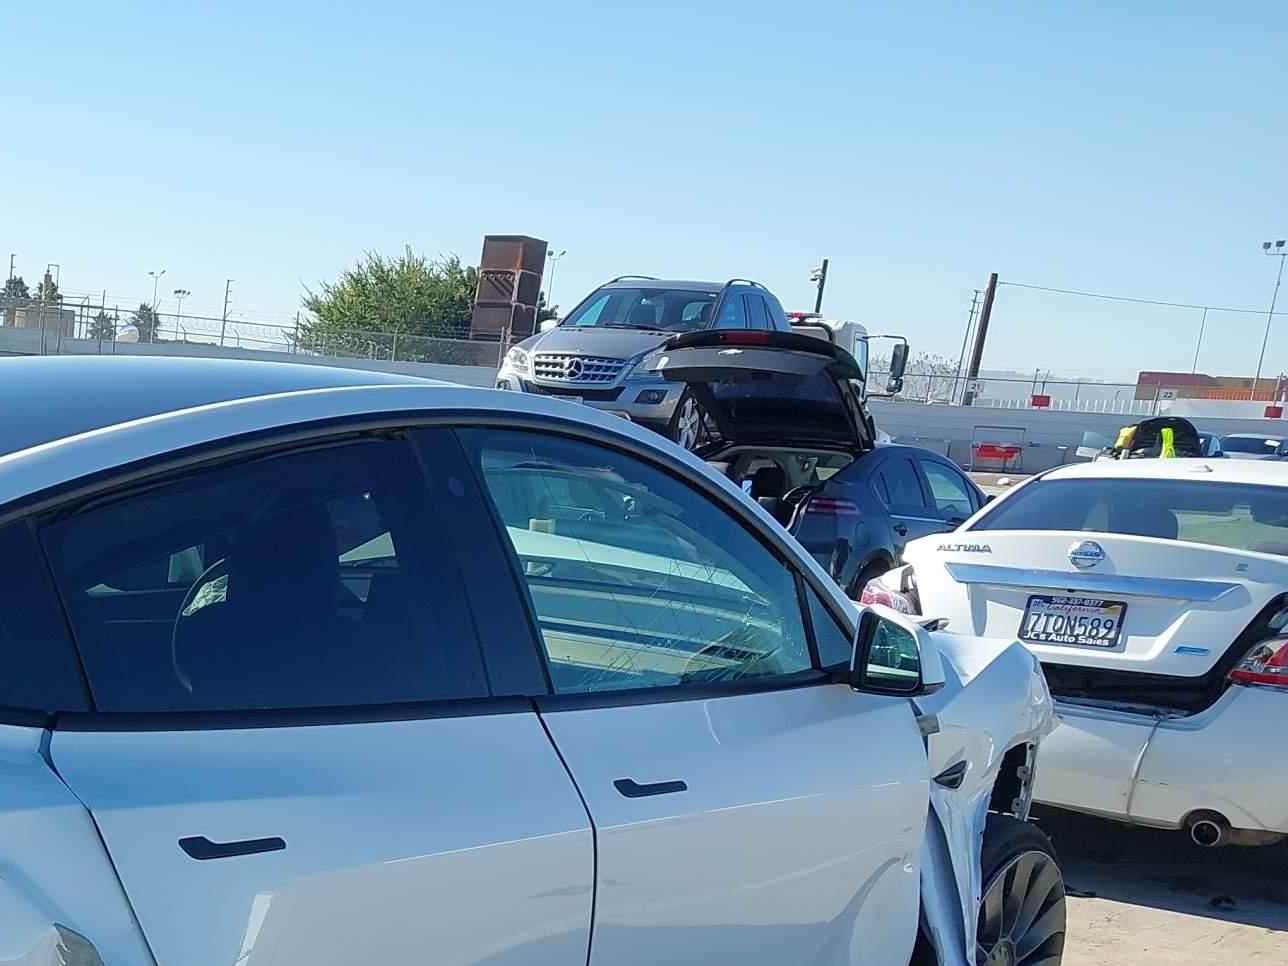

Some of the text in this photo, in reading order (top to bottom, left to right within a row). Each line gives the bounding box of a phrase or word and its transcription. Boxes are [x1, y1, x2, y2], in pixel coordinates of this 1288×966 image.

[936, 543, 993, 554] ALTIMA
[1070, 550, 1101, 558] NISSAN
[1046, 603, 1105, 615] California
[1047, 632, 1076, 643] Auto
[1076, 634, 1110, 646] Sales
